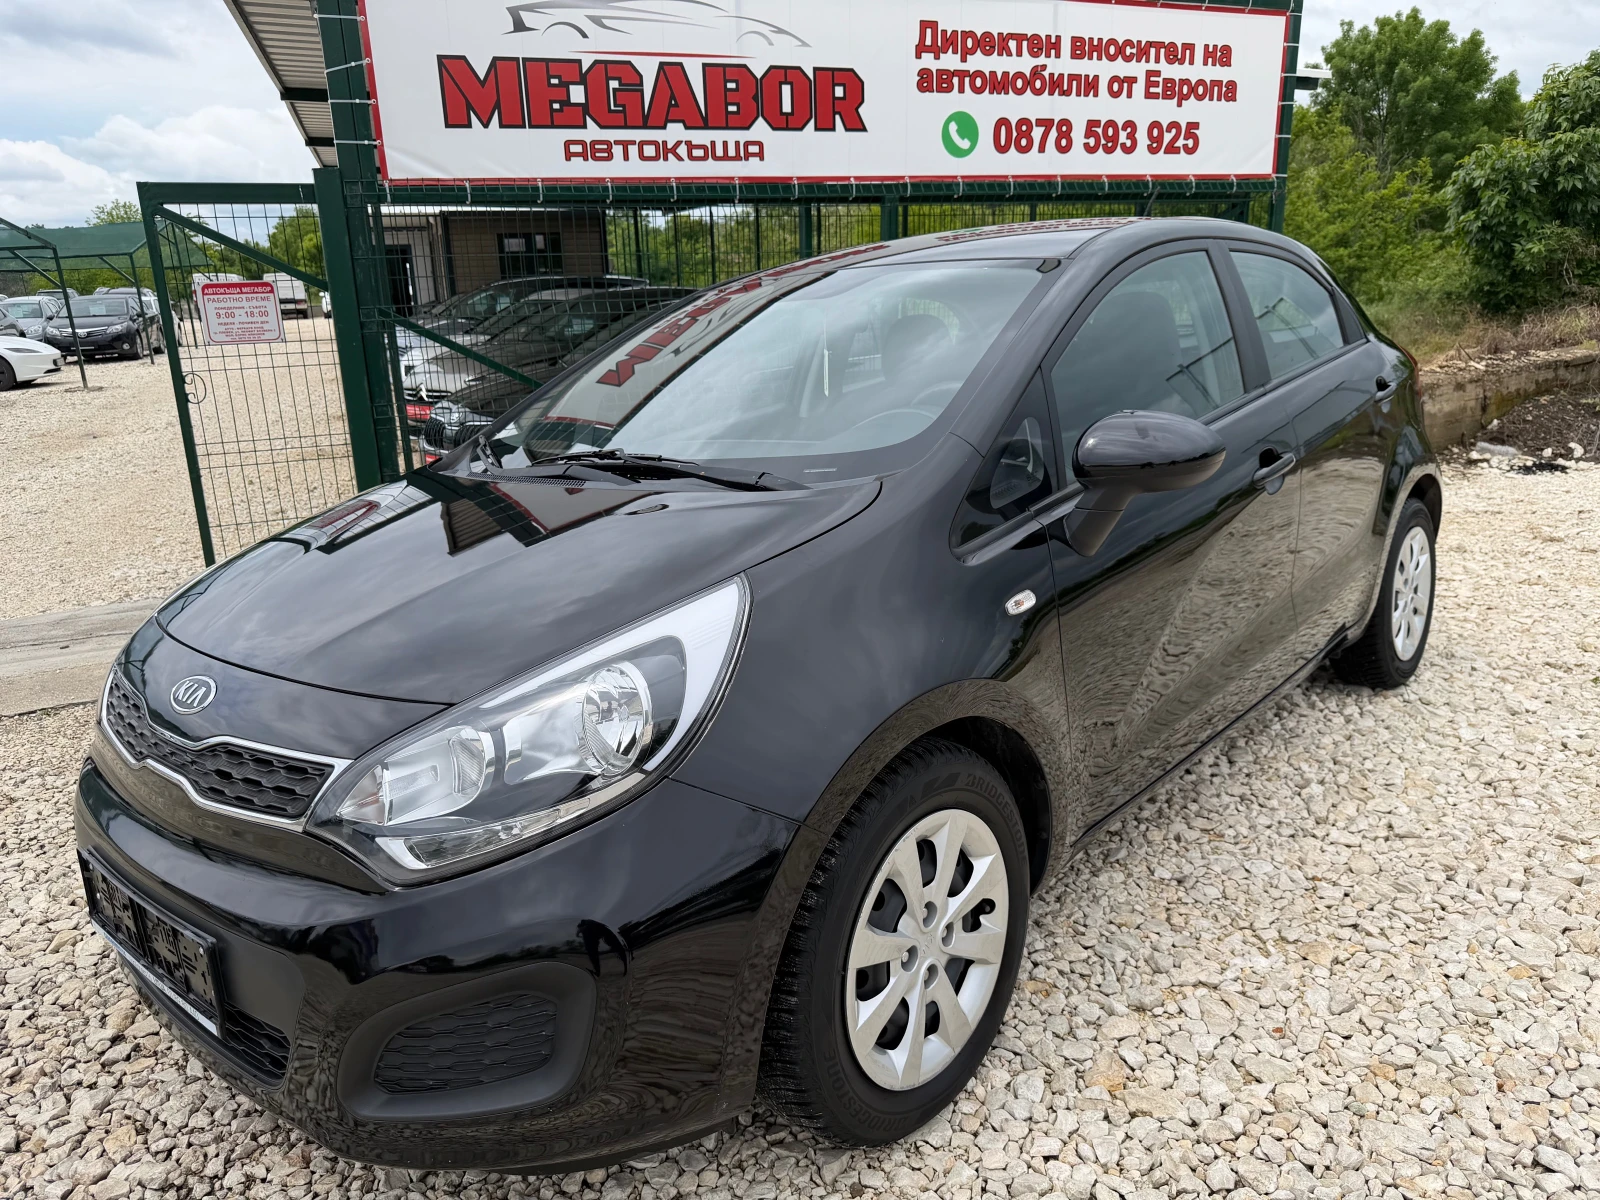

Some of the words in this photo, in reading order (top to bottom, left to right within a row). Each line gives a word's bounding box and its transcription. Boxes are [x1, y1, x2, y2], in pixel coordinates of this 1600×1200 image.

[915, 19, 1062, 62] Директен
[1070, 35, 1195, 66] вносител
[1203, 43, 1233, 67] на
[436, 54, 868, 133] MEGABOR
[916, 64, 1099, 98] автомобили
[1107, 74, 1138, 99] от
[1144, 70, 1238, 107] Европа
[992, 117, 1073, 155] 0878
[1082, 119, 1138, 155] 593
[1146, 120, 1200, 156] 925
[215, 311, 236, 319] 9:00
[244, 310, 269, 318] 18:00
[175, 680, 207, 707] KIA
[963, 773, 1027, 866] BRIDGESTONE
